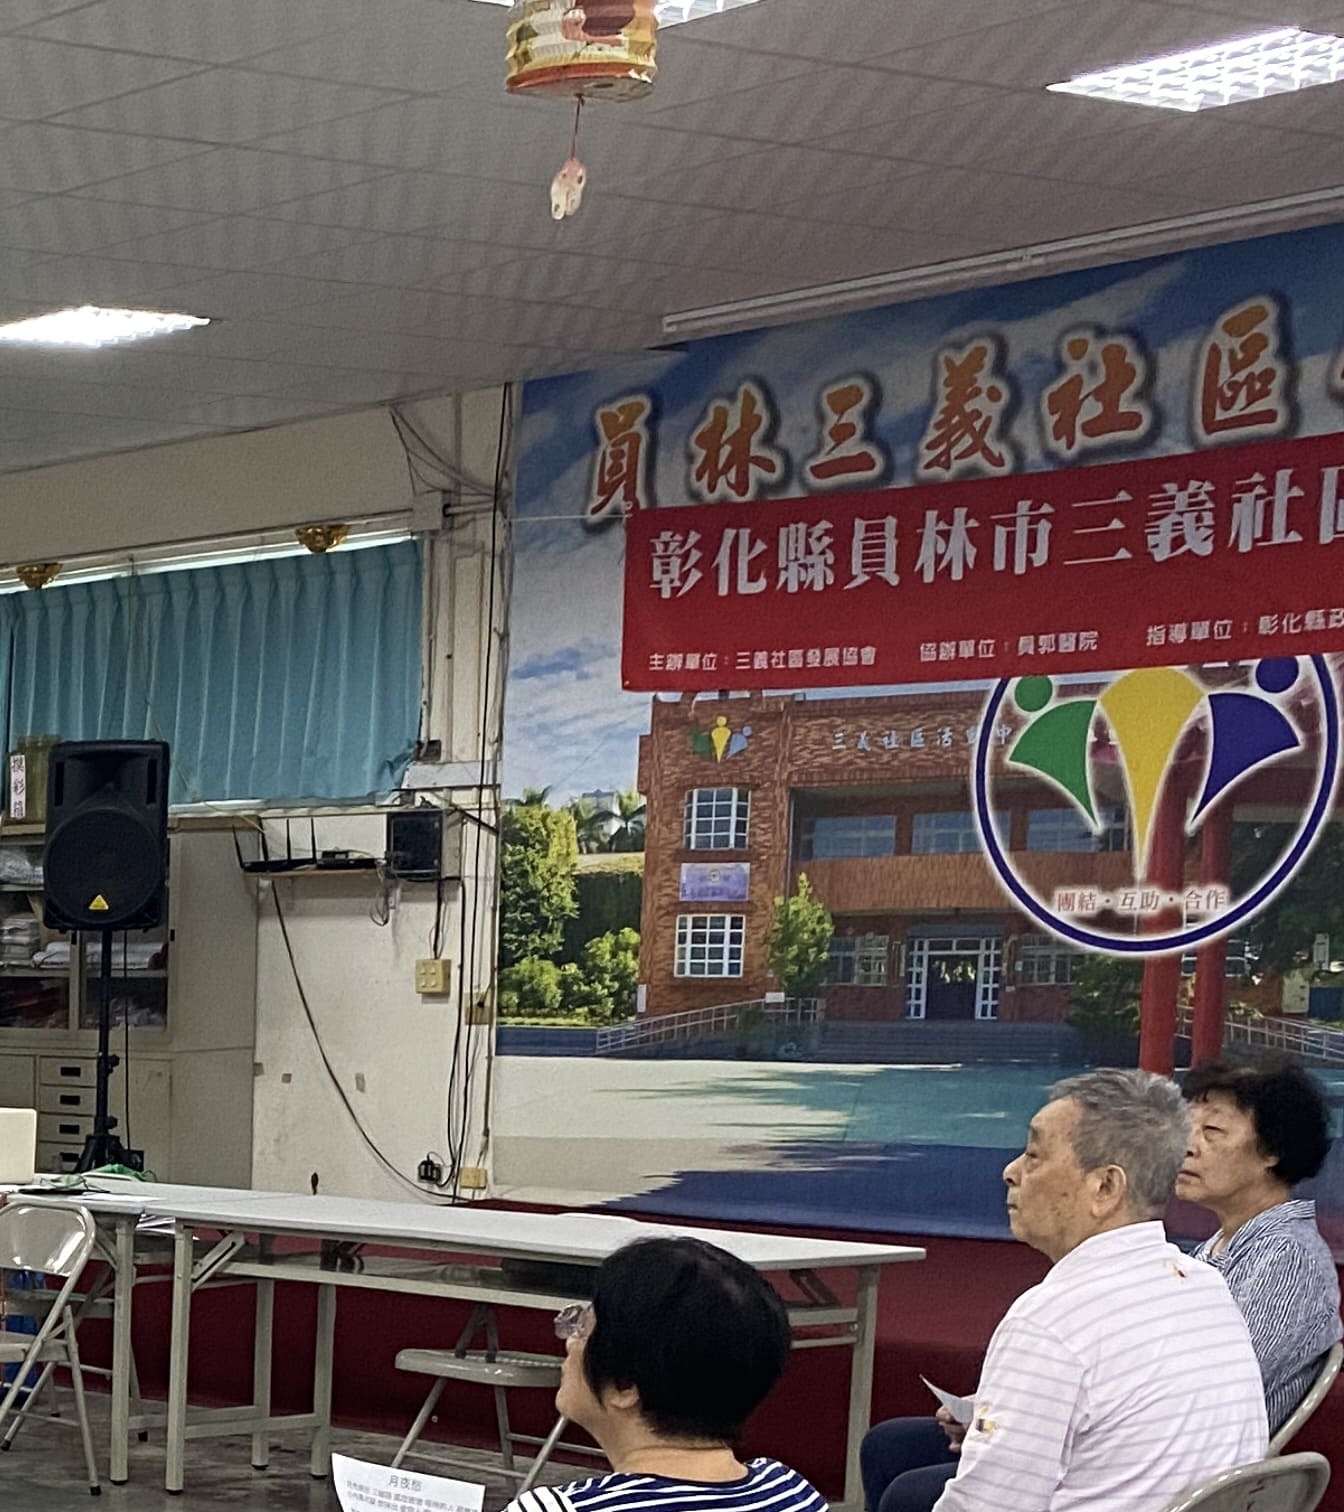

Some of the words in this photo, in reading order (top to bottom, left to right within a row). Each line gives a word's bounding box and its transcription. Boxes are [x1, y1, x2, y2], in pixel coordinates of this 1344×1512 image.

[588, 303, 1344, 518] 員林三義社區
